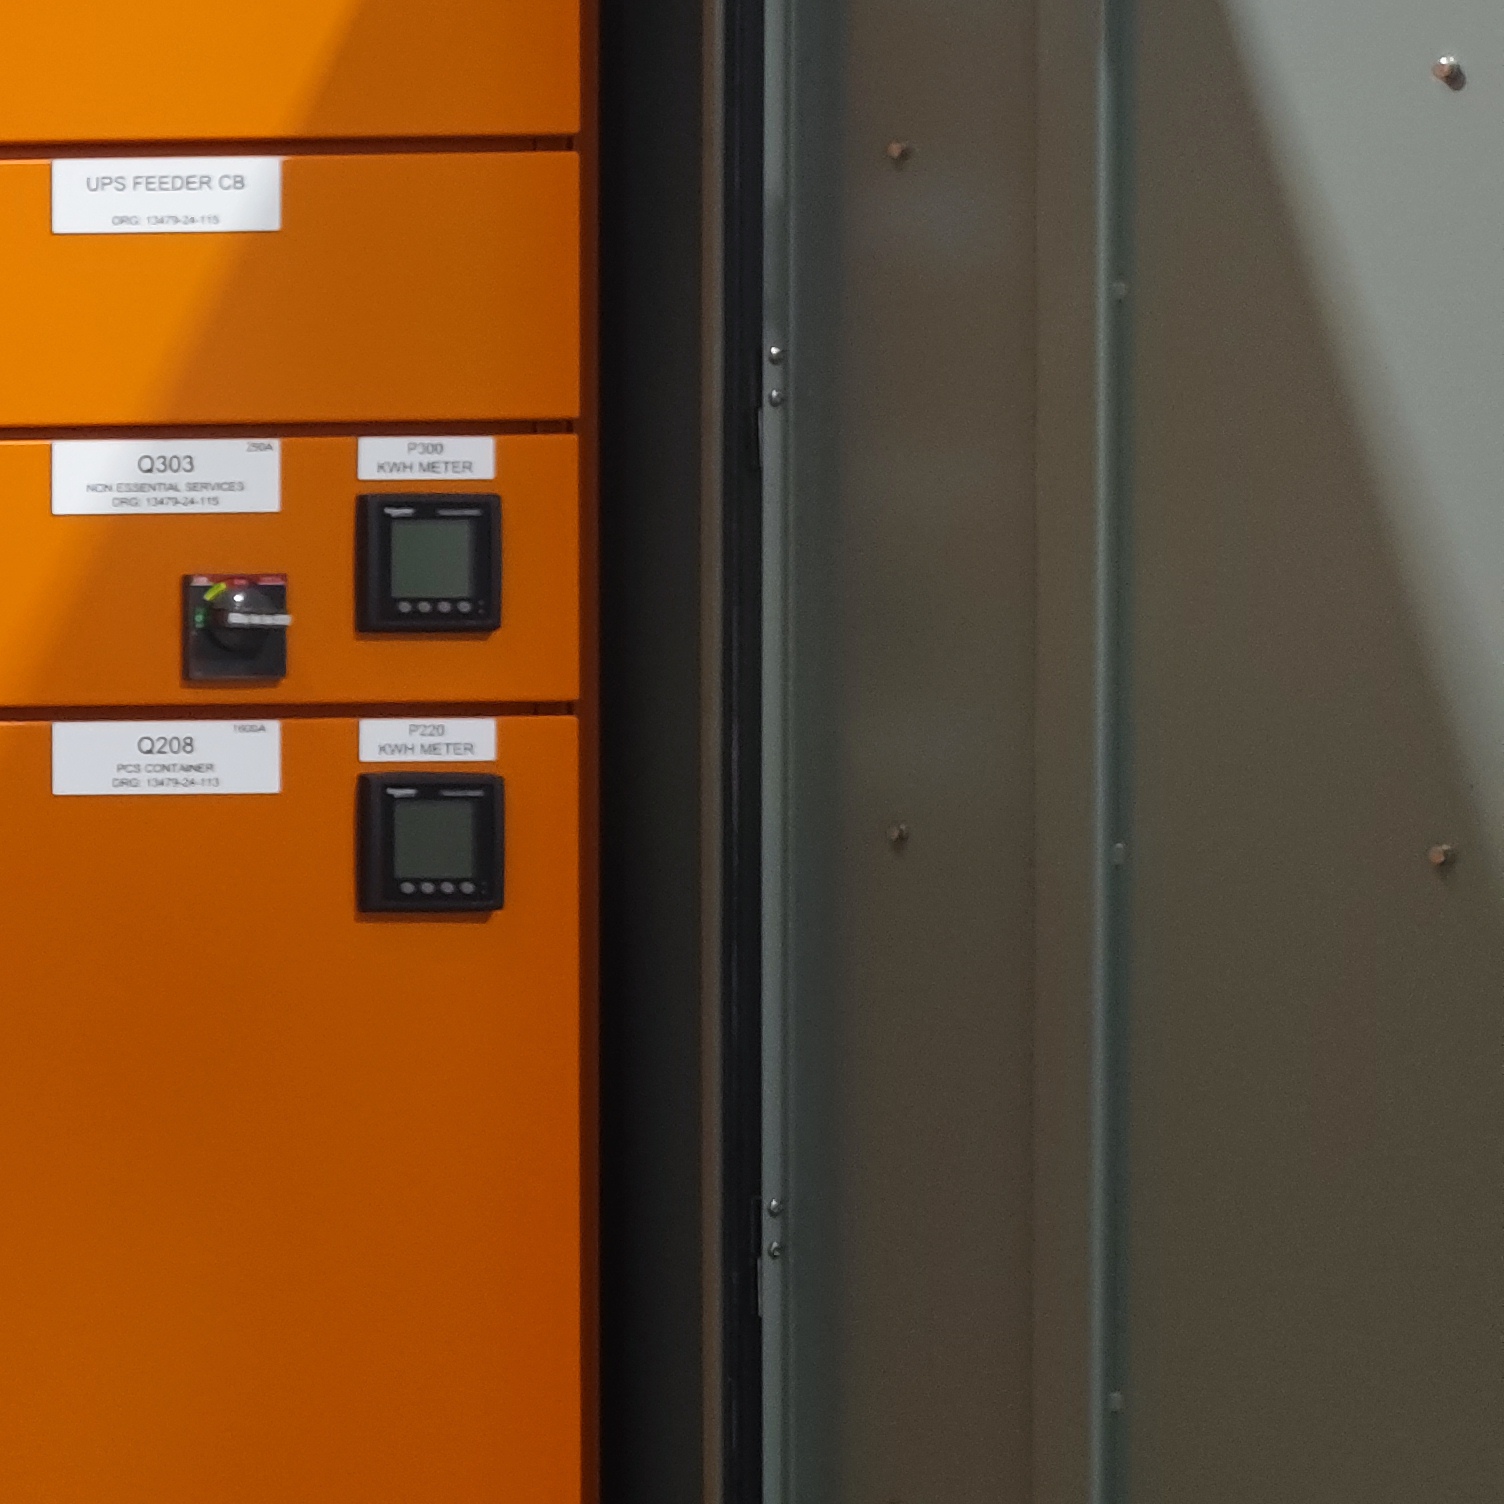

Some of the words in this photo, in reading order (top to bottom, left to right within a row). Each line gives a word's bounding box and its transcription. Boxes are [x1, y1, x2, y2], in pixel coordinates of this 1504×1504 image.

[86, 176, 127, 192] UPS
[133, 175, 213, 192] FEEDER
[218, 175, 246, 191] CB
[407, 442, 445, 455] P300
[137, 455, 195, 474] Q303
[377, 461, 414, 474] KWH
[418, 460, 474, 474] METER
[86, 483, 113, 493] NON
[116, 482, 181, 493] ESSENTIAL
[185, 482, 245, 492] SERVICES
[408, 724, 446, 737] P220
[137, 736, 195, 756] Q208
[378, 743, 415, 756] KWH
[419, 742, 475, 755] METER
[117, 763, 141, 774] PCS
[145, 763, 216, 773] CONTAINER
